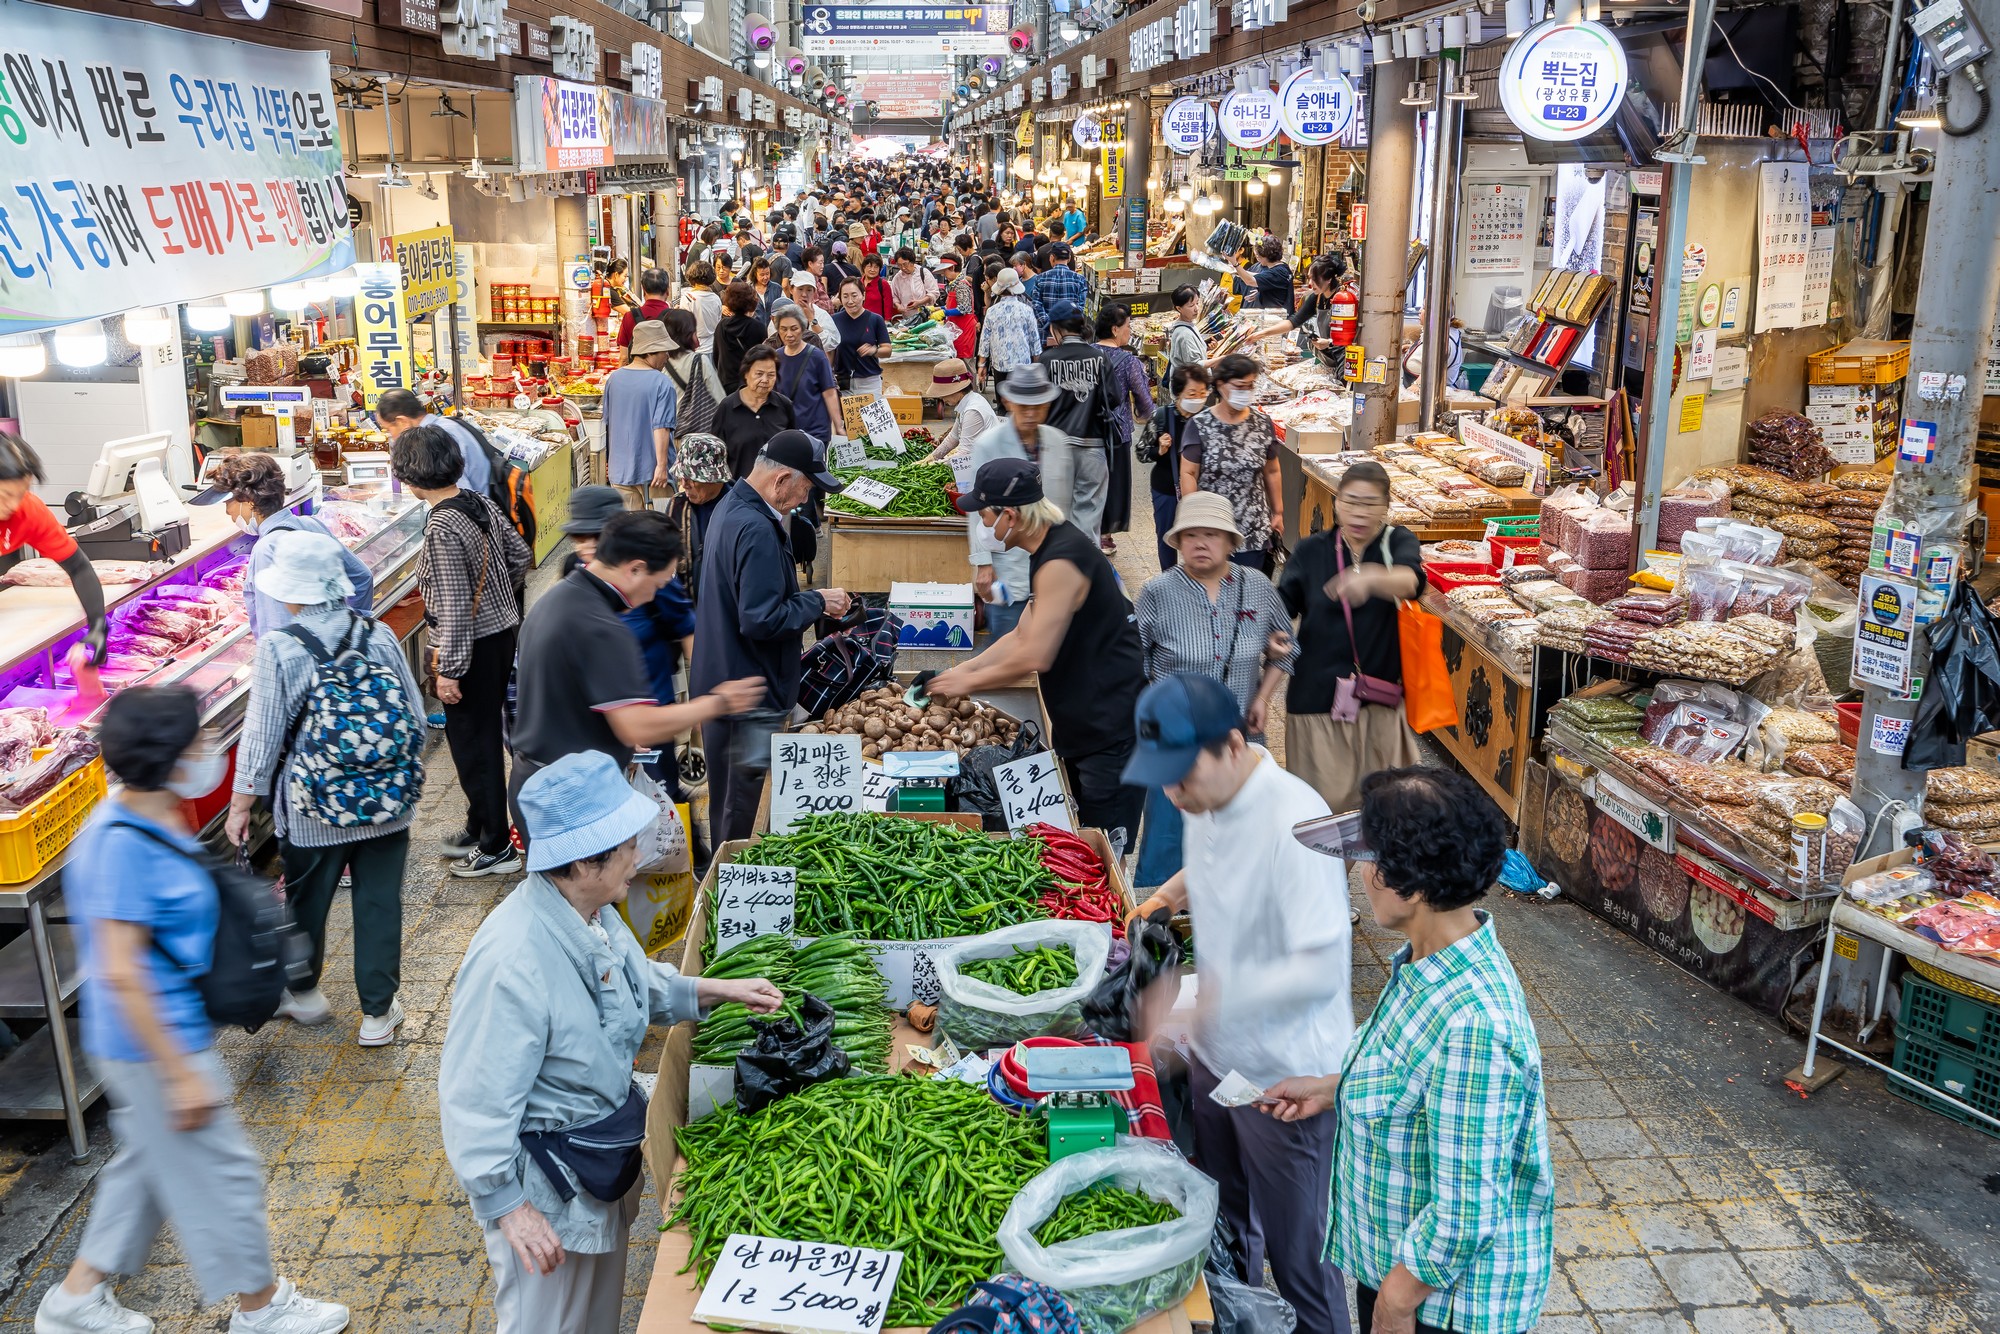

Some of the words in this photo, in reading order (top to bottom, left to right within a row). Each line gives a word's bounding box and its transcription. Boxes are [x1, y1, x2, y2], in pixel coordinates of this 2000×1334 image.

[1296, 92, 1340, 110] 슬애네
[1536, 87, 1598, 103] (광성유통)
[85, 66, 165, 148] 바로
[169, 72, 256, 152] 우리집
[255, 82, 333, 155] 식탁으로
[561, 89, 597, 139] 진광젓갈
[1232, 104, 1271, 120] 하나김
[1295, 112, 1341, 121] (수제강정)
[1550, 107, 1580, 118] 나-23
[1307, 123, 1328, 132] 나-24
[1783, 169, 1788, 183] 9
[141, 180, 276, 256] 도매가로
[396, 235, 453, 291] 홍어회무침
[407, 286, 449, 313] 010-2760-3360
[1131, 302, 1149, 316] 코코넛
[360, 269, 403, 388] 홍어무침
[1050, 356, 1103, 386] HARLEY
[1844, 430, 1862, 440] 대추
[1877, 593, 1897, 604] 고유가
[909, 611, 932, 619] 운두령
[933, 611, 955, 619] 풋고추
[1862, 655, 1878, 667] 고유가
[1882, 718, 1901, 732] 핸드폰
[812, 742, 850, 764] 매운
[795, 795, 854, 814] 3000
[1027, 786, 1066, 816] 4000
[1610, 801, 1649, 834] STEWART
[654, 871, 691, 887] WATER
[744, 891, 794, 910] 4000
[1603, 898, 1639, 930] 광성상회
[1658, 932, 1704, 969] 966-4873
[733, 1240, 764, 1269] 안
[770, 1282, 858, 1312] 5000
[856, 1301, 882, 1328] 원
